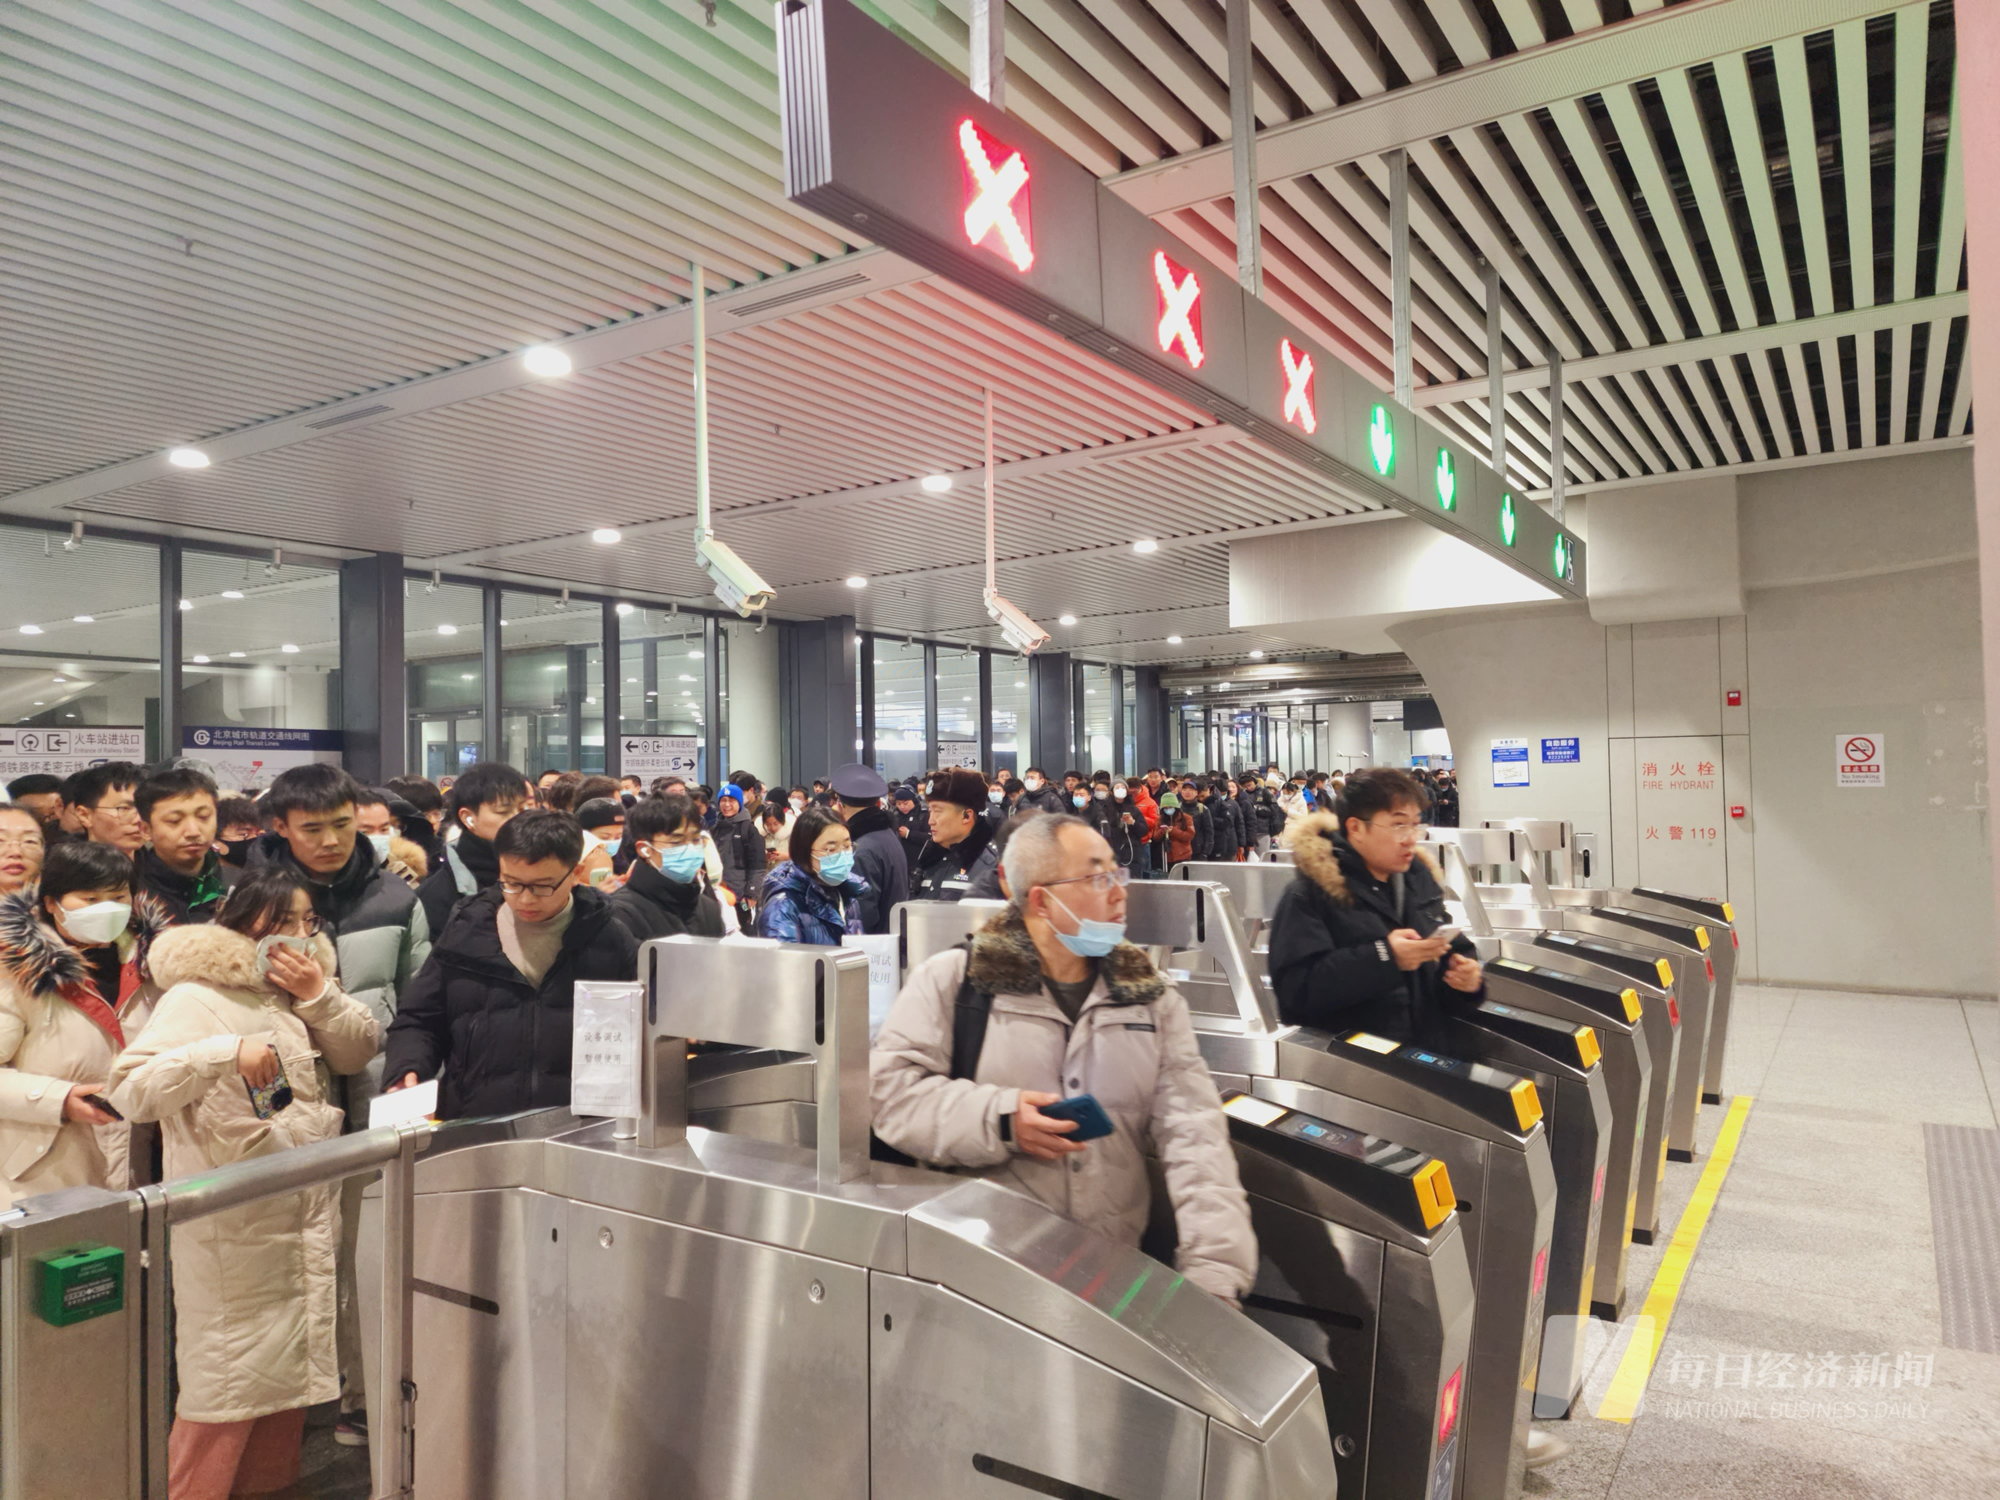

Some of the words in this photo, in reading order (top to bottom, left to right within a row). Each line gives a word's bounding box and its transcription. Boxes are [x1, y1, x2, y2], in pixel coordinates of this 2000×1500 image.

[74, 733, 140, 746] 火车站进站口
[213, 730, 310, 741] 北京城市轨道交通线网图
[213, 739, 232, 747] Beijing
[665, 741, 696, 749] 火车站进站口
[103, 747, 122, 755] Railway
[1642, 761, 1715, 777] 消火栓
[1843, 765, 1878, 773] 禁止吸烟
[1642, 780, 1664, 790] FIRE
[1670, 780, 1715, 790] HYDRANT
[584, 1032, 623, 1043] 设备调试
[584, 1053, 621, 1065] 暂缓使用
